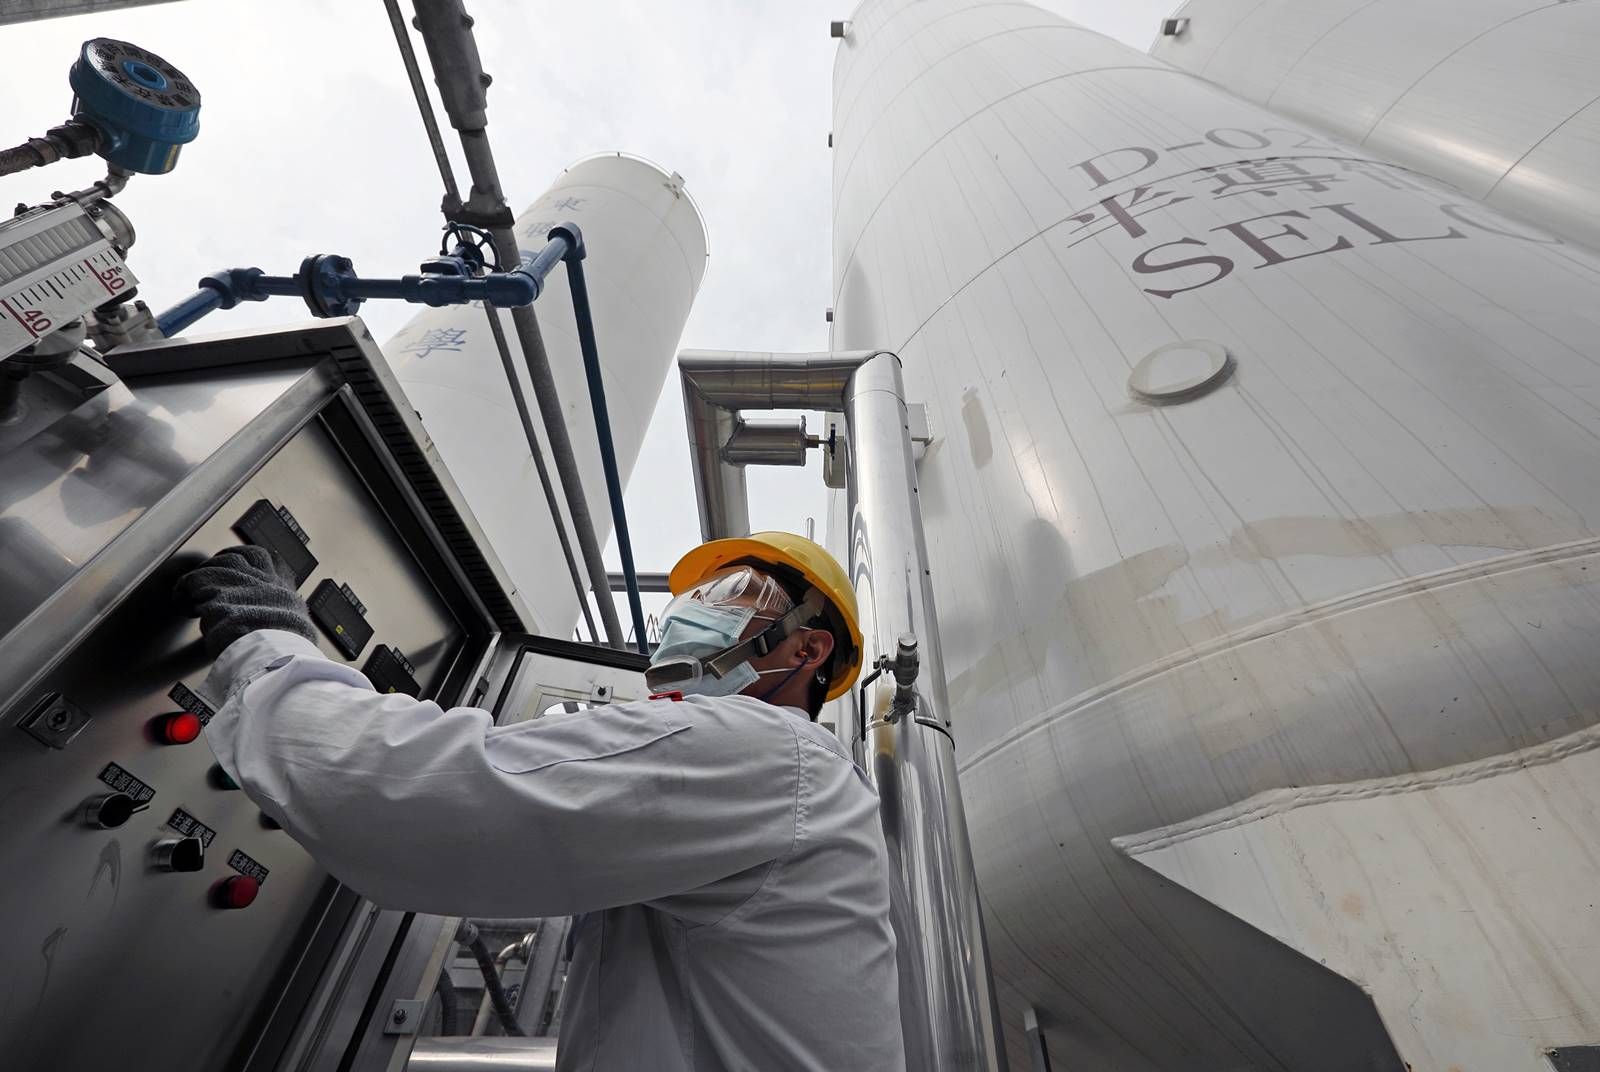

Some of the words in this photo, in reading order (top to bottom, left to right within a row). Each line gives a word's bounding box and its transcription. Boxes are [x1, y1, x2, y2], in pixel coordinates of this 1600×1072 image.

[1069, 127, 1343, 191] D-02
[101, 266, 126, 291] 50
[24, 308, 52, 333] 40
